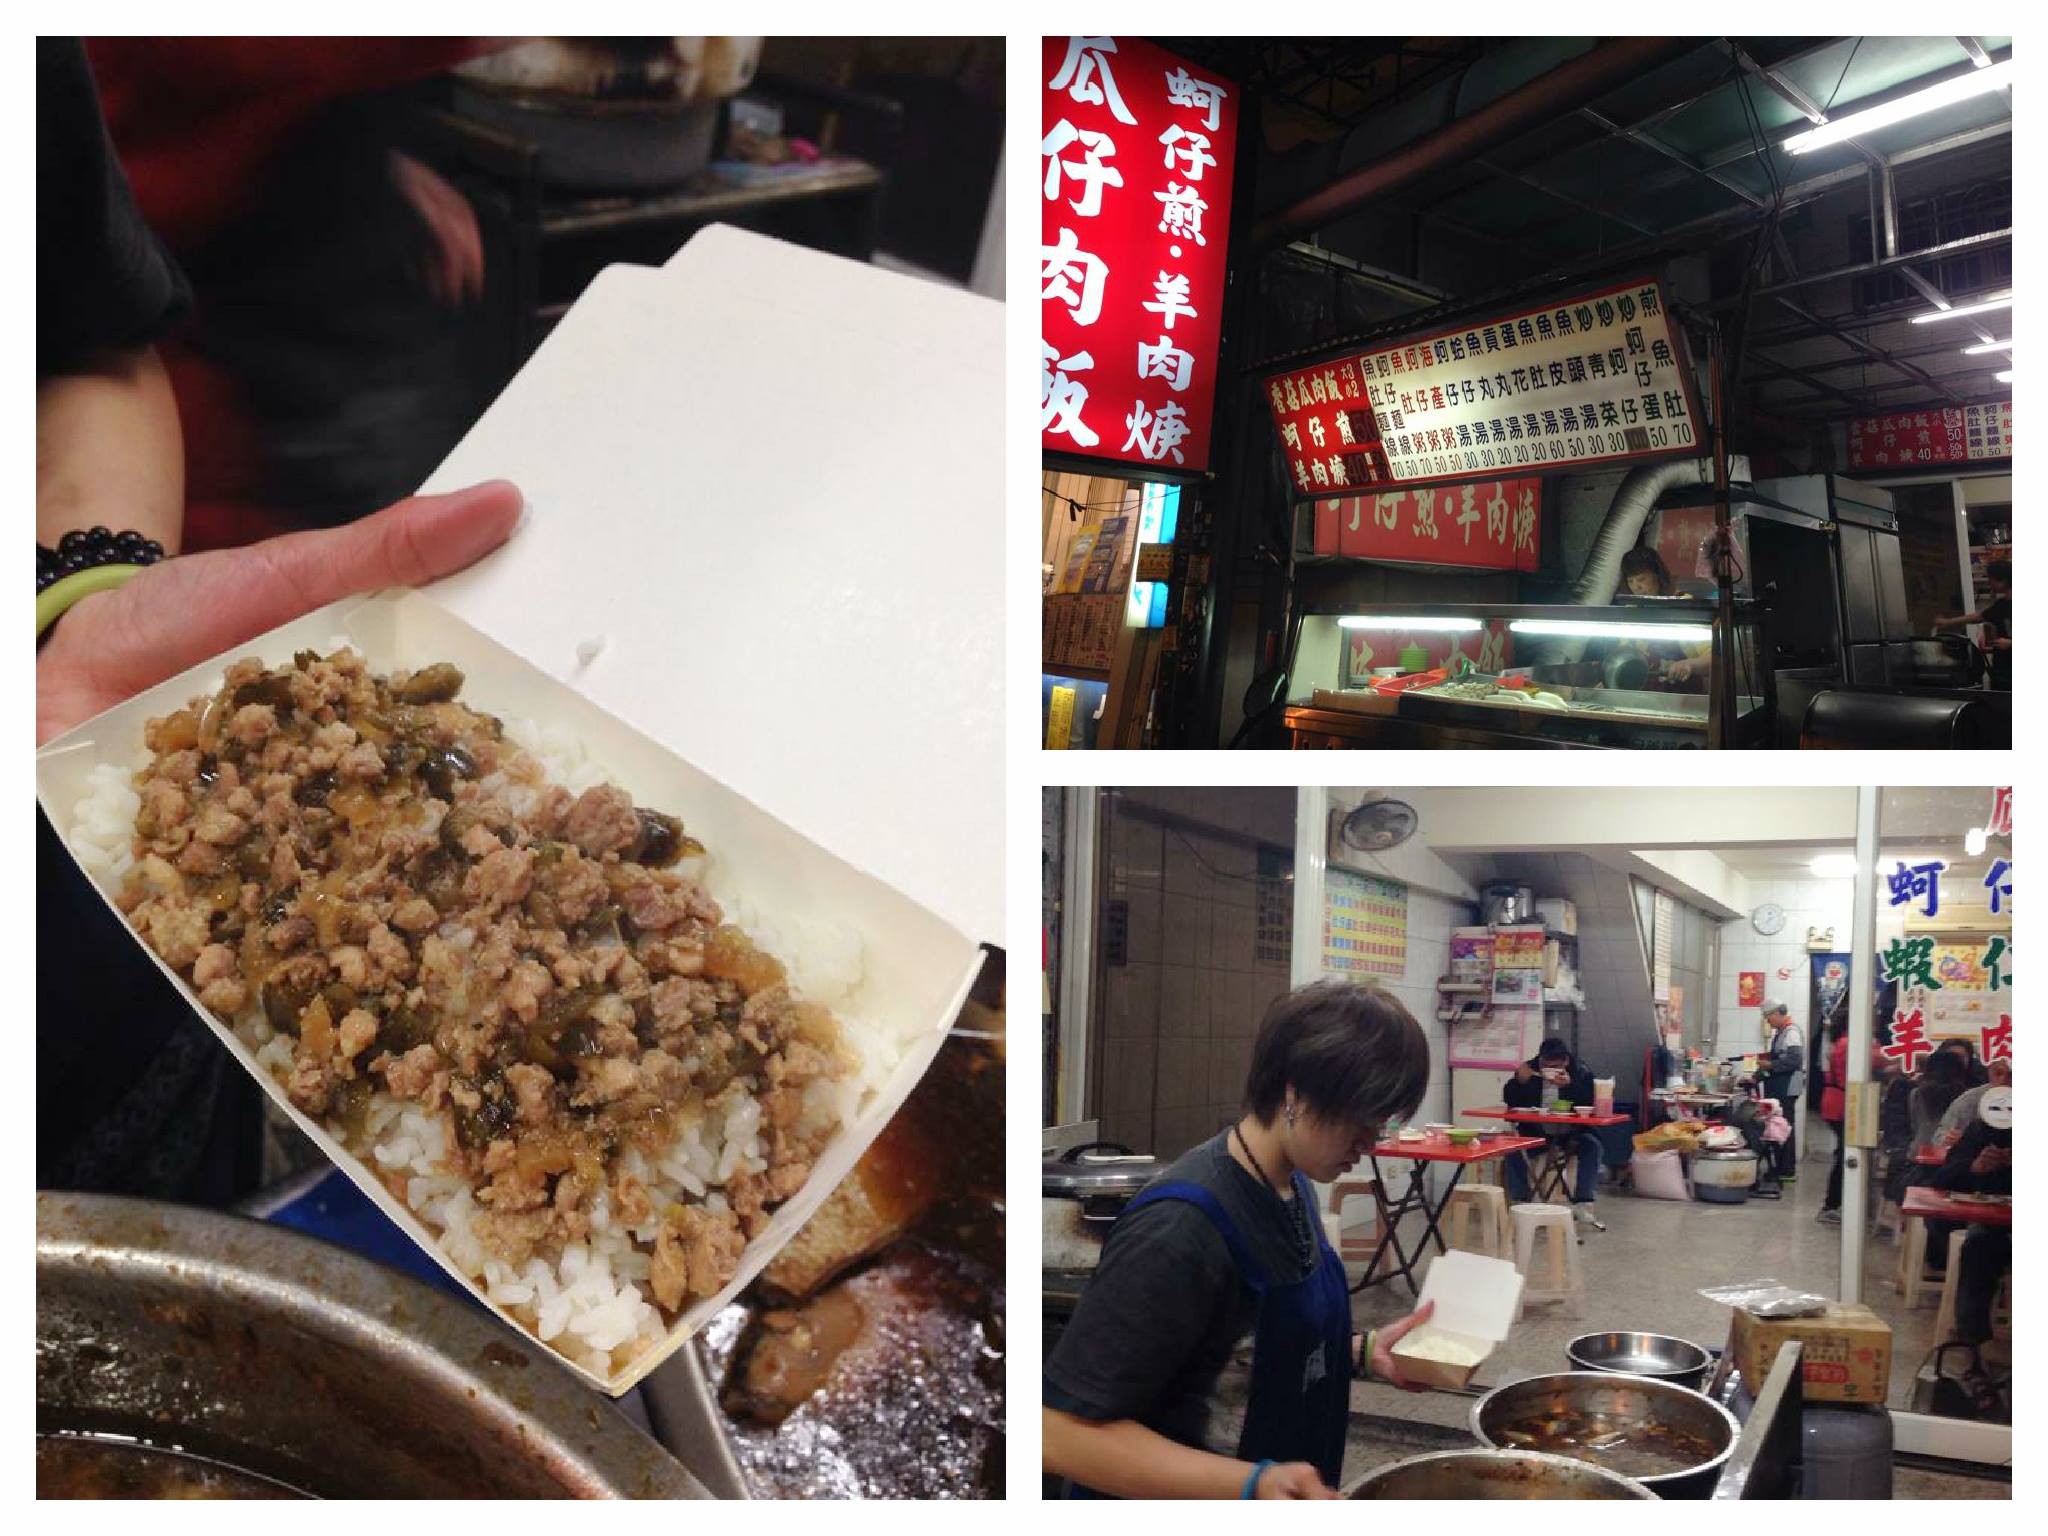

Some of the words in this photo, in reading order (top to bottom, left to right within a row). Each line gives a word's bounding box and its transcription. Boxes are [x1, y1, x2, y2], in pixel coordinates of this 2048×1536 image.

[1271, 369, 1344, 414] 香菇瓜肉飯
[1281, 409, 1356, 451] 蚵仔煎
[1650, 425, 1668, 447] 50
[1673, 422, 1691, 444] 70
[1947, 428, 1960, 441] 50
[1550, 440, 1565, 459] 60
[1570, 437, 1585, 457] 50
[1588, 434, 1604, 454] 30
[1608, 431, 1625, 451] 30
[1481, 449, 1495, 467] 30
[1497, 447, 1512, 465] 20
[1514, 444, 1530, 462] 20
[1532, 442, 1547, 461] 20
[1918, 448, 1931, 461] 40
[1392, 461, 1405, 478] 70
[1406, 459, 1418, 477] 50
[1420, 457, 1433, 475] 70
[1435, 456, 1448, 473] 50
[1450, 453, 1463, 471] 50
[1465, 452, 1479, 470] 30
